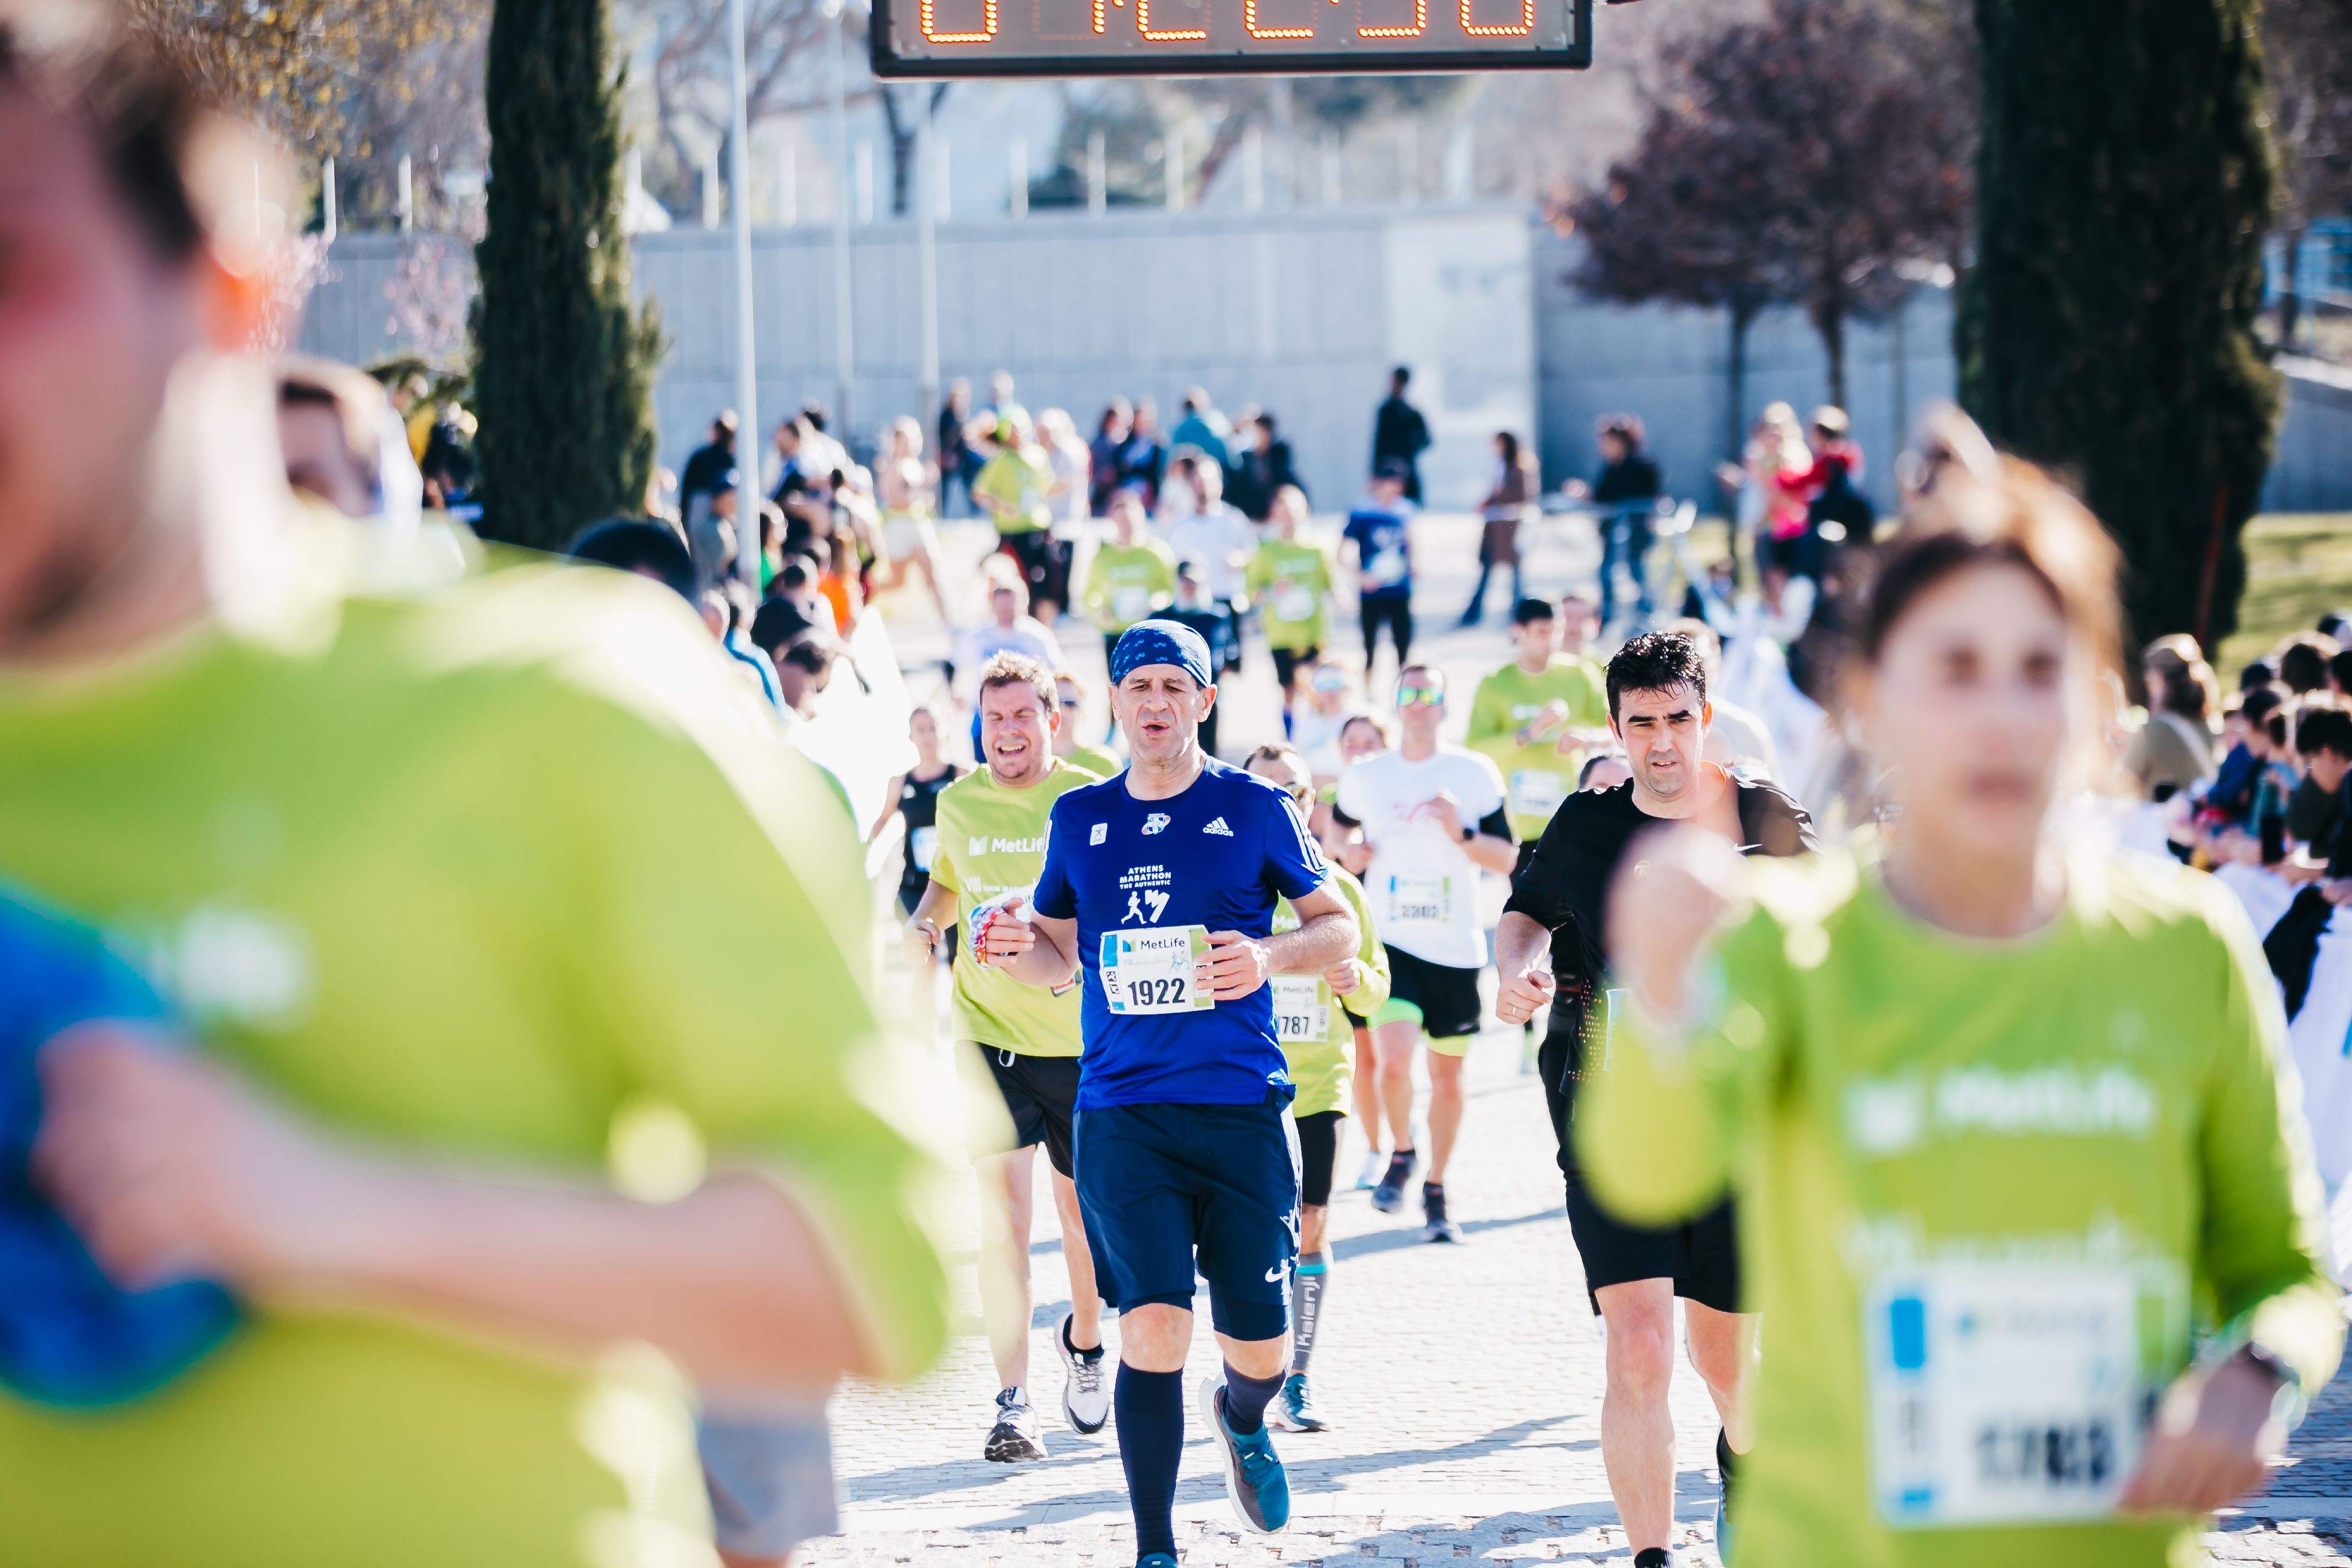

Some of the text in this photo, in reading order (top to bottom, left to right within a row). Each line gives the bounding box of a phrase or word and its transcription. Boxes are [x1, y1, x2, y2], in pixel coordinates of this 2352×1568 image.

[1203, 827, 1233, 837] adidas
[991, 837, 1044, 853] MetLif
[1128, 864, 1164, 875] ATHENS
[1119, 872, 1171, 884] MARATHON
[1134, 880, 1171, 888] AUTHENTIC
[1141, 938, 1186, 950] MetLife
[1128, 978, 1186, 1006] 1922
[1277, 1016, 1310, 1035] 787
